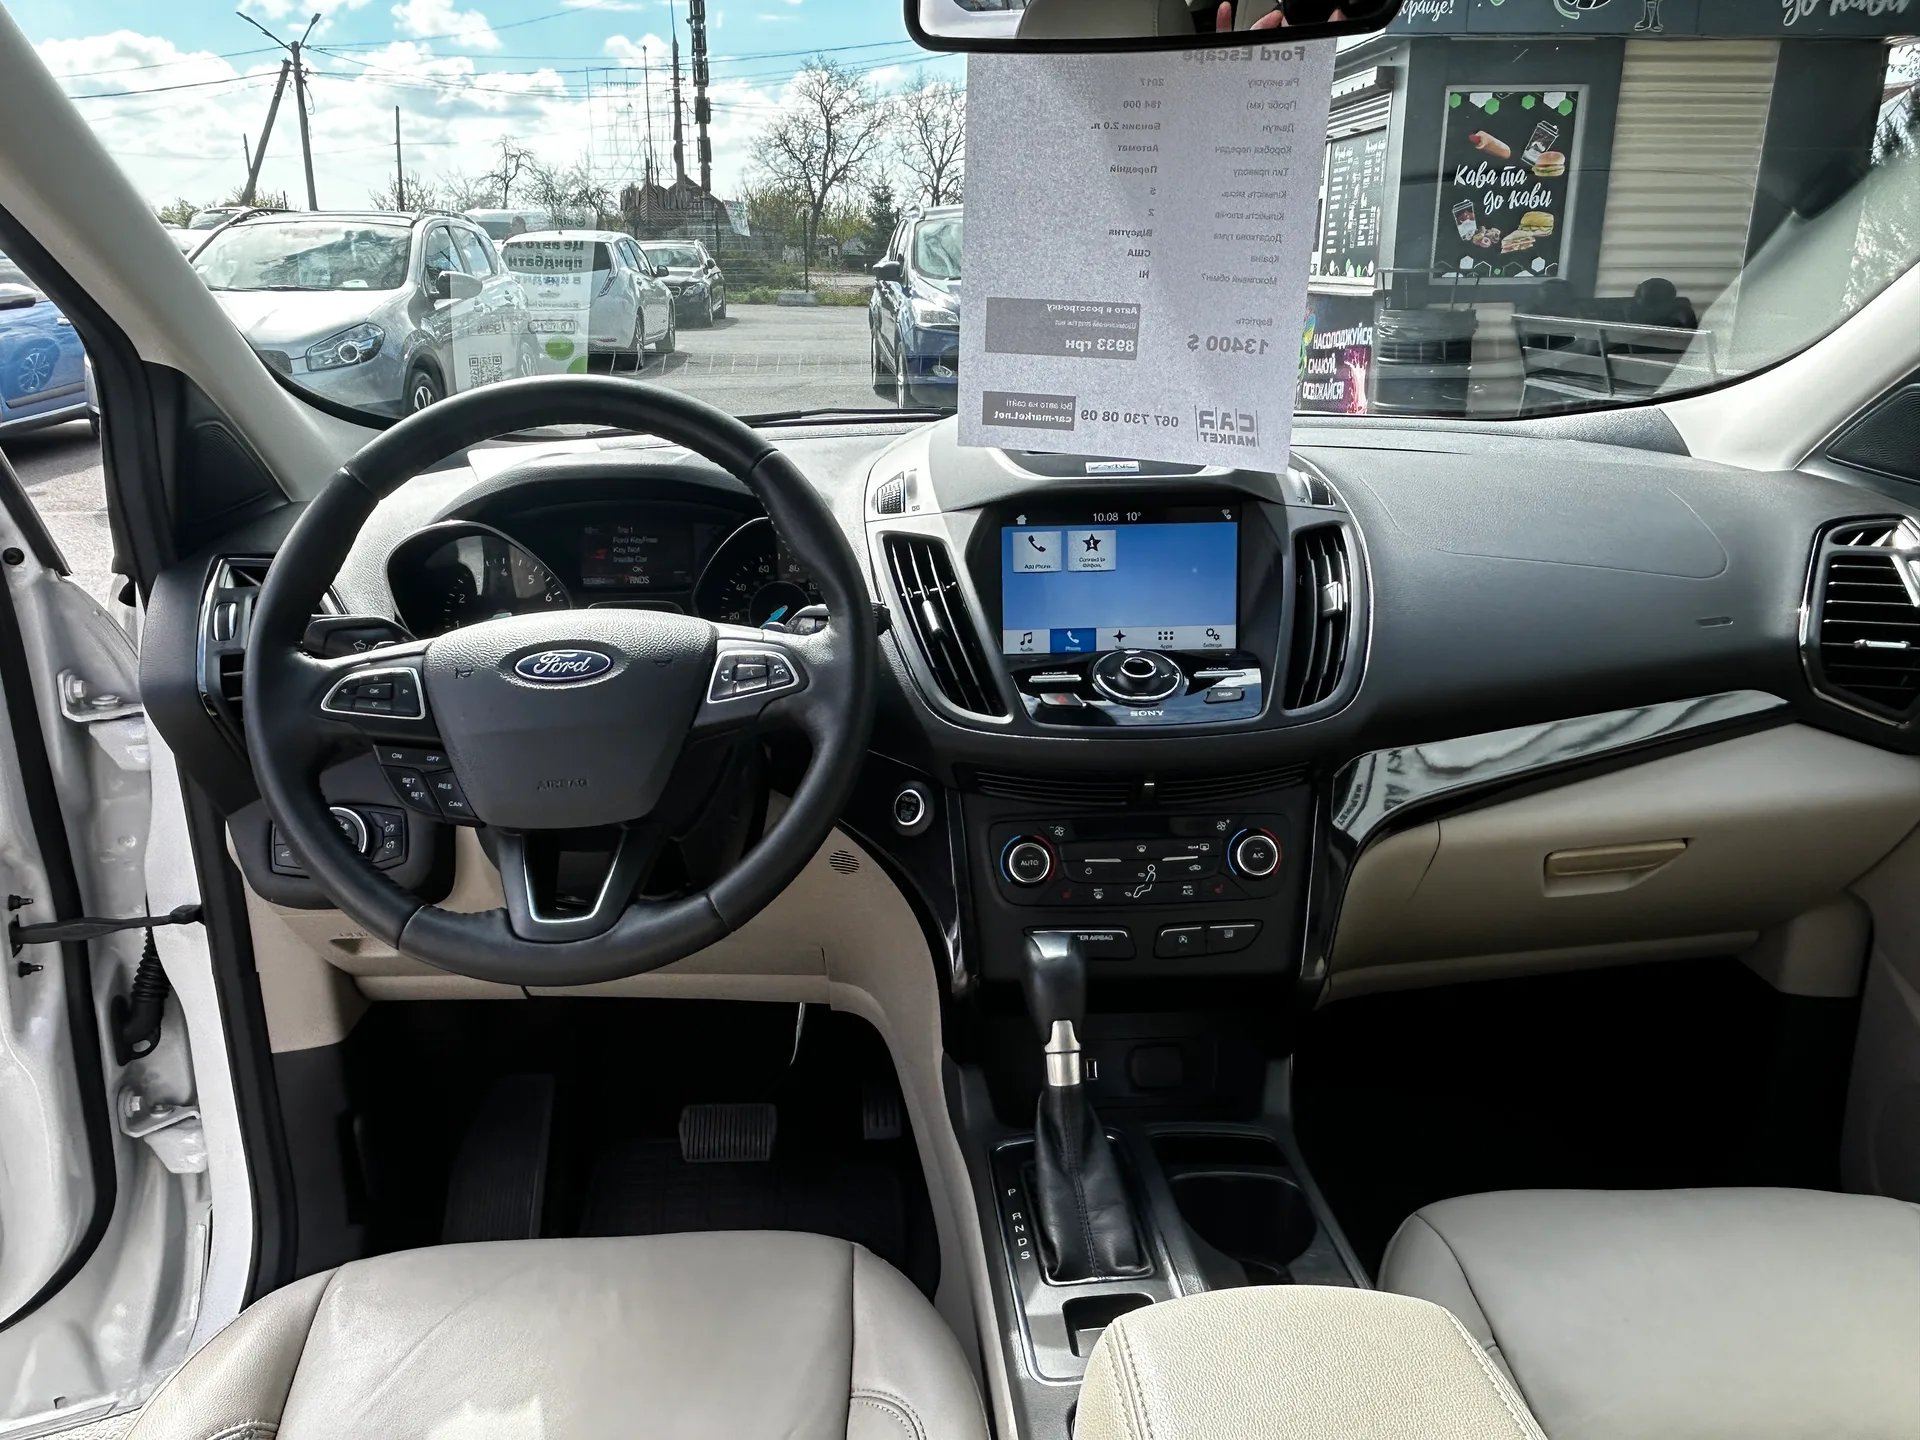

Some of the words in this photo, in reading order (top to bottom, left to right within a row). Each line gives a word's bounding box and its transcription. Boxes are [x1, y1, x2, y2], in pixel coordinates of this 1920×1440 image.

[1453, 160, 1498, 189] Кава
[1500, 165, 1528, 187] та
[1483, 190, 1505, 215] до
[1507, 182, 1553, 209] кави
[735, 583, 747, 592] 40
[458, 593, 466, 604] 2
[545, 592, 553, 602] 6
[728, 611, 740, 620] 20
[532, 652, 592, 674] Ford
[1129, 710, 1164, 718] SONY
[1252, 851, 1265, 859] A/C
[1020, 859, 1039, 867] AUTO
[1007, 1188, 1017, 1197] P
[1012, 1212, 1022, 1221] R
[1014, 1224, 1025, 1233] N
[1017, 1237, 1028, 1247] D
[1020, 1250, 1031, 1260] S
